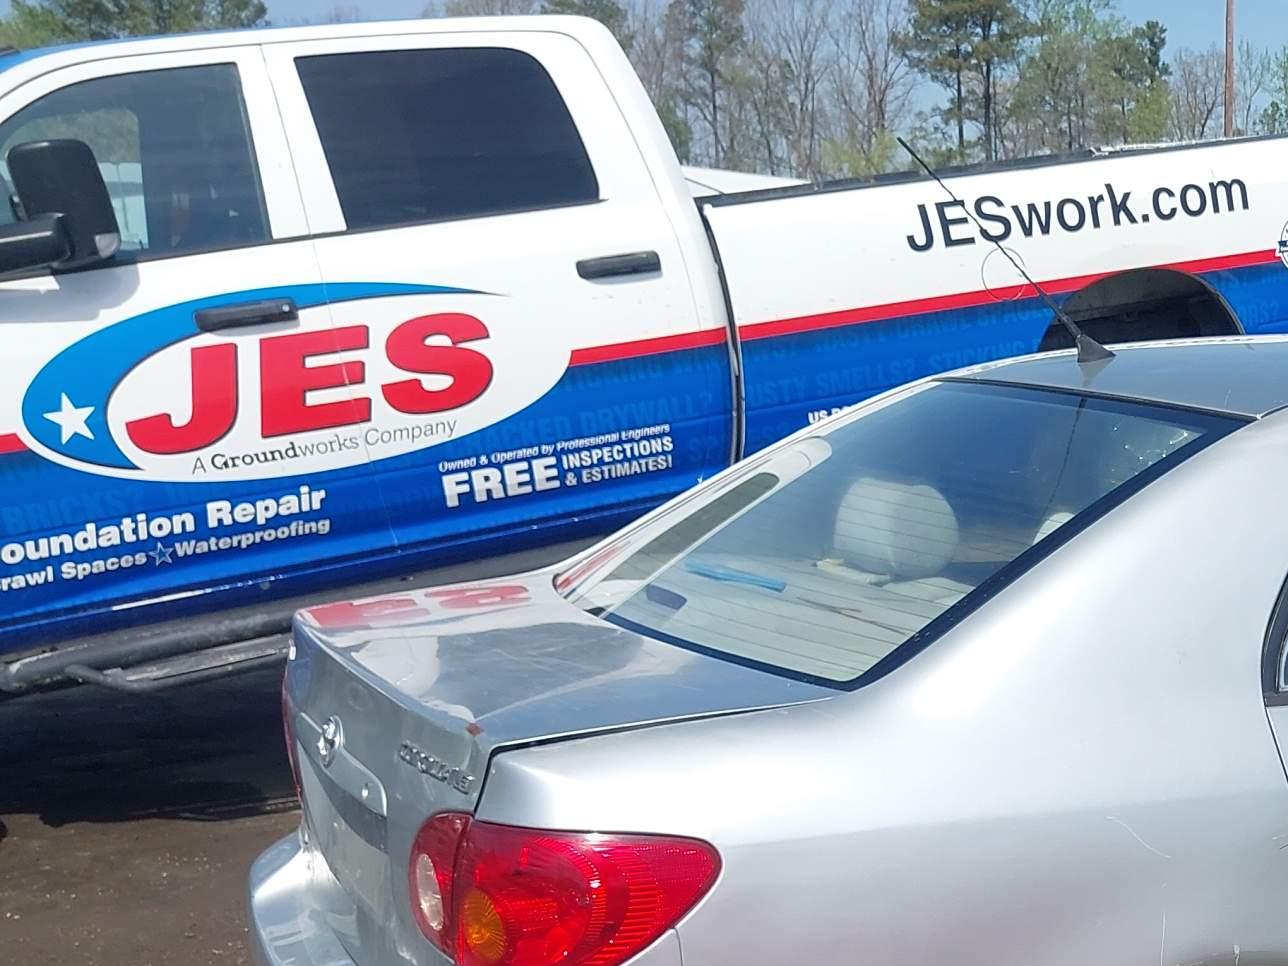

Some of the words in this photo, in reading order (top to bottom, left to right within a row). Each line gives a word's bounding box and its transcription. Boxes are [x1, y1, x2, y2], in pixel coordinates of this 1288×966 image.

[907, 176, 1250, 253] JESwork.com
[125, 312, 494, 455] JES
[192, 457, 206, 475] A
[211, 433, 359, 471] Groundworks
[364, 419, 458, 446] Company
[438, 459, 476, 474] Owned
[480, 456, 489, 466] &
[491, 448, 539, 464] Operated
[540, 444, 555, 457] by
[556, 433, 619, 452] Professional
[621, 424, 671, 442] Engineers
[562, 436, 674, 470] INSPECTIONS
[565, 472, 577, 487] &
[582, 454, 673, 484] ESTIMATES!
[442, 456, 561, 508] FREE
[0, 512, 196, 565] oundation
[206, 485, 326, 529] Repair
[0, 565, 54, 592] rawl
[61, 551, 148, 580] Spaces
[175, 517, 331, 557] Waterproofing
